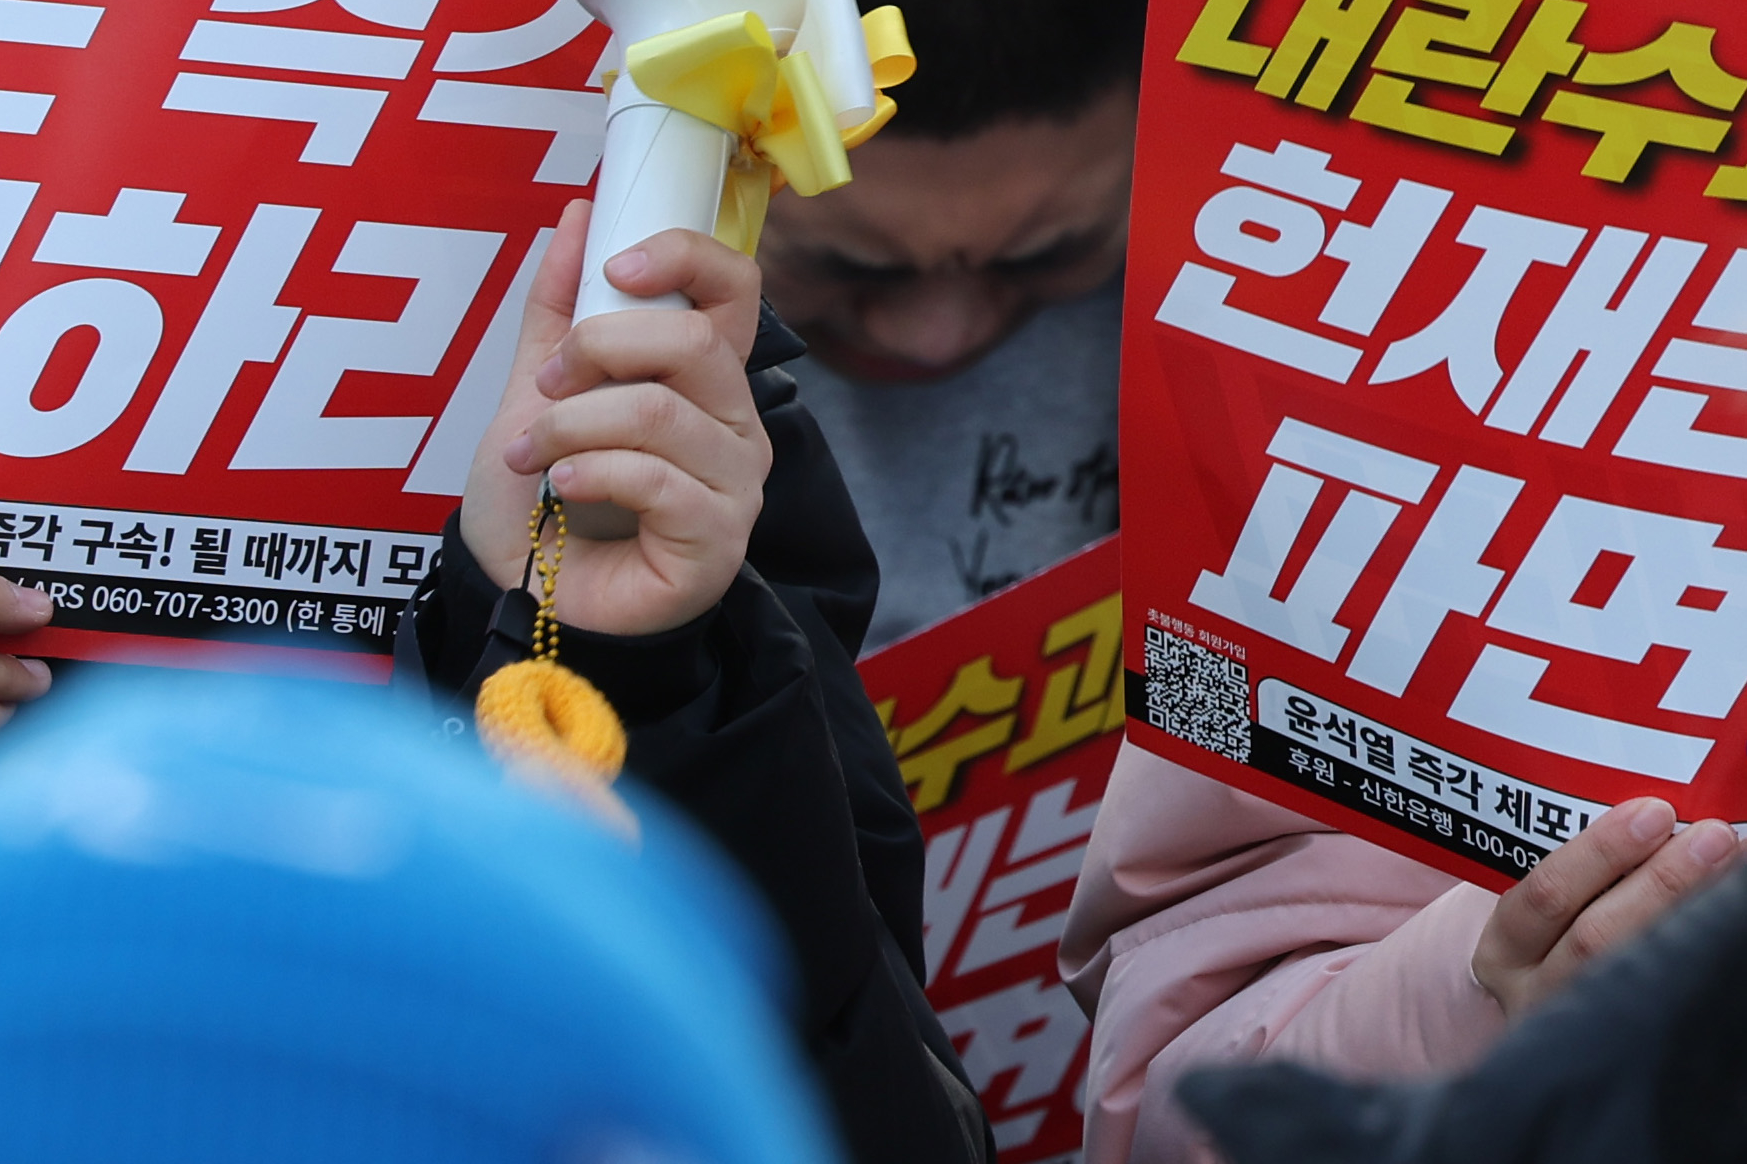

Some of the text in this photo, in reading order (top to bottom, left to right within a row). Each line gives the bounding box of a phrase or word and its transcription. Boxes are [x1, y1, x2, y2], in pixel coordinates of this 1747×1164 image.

[72, 519, 176, 569] 구속!
[190, 528, 231, 576] 될
[243, 533, 372, 588] 때까지
[91, 585, 279, 626] 060-707-3300
[331, 602, 386, 637] 통에
[1198, 623, 1247, 661] 회원가입
[1284, 694, 1396, 775] 윤석열
[1407, 746, 1484, 813] 즉각
[1288, 748, 1336, 788] 후원
[1359, 779, 1454, 837] 신한은행
